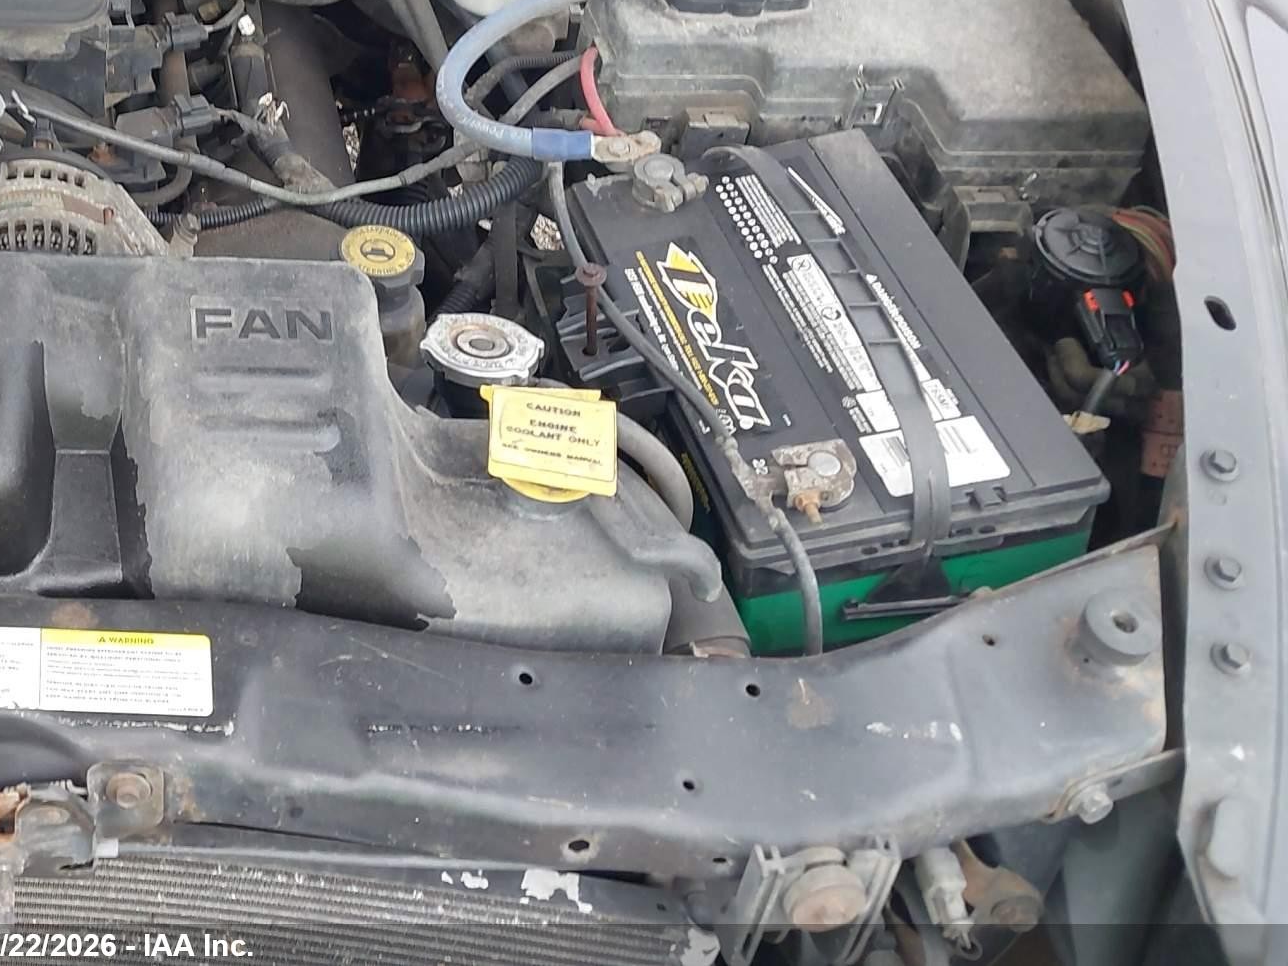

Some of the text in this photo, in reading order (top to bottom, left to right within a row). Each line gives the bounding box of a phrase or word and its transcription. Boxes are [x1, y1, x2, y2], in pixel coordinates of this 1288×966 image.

[194, 307, 333, 340] FAN
[656, 242, 771, 430] Deka
[526, 402, 581, 417] CAUTION
[529, 419, 577, 434] ENGINE
[506, 426, 601, 448] COOLANT ONLY
[109, 636, 155, 645] WARNING
